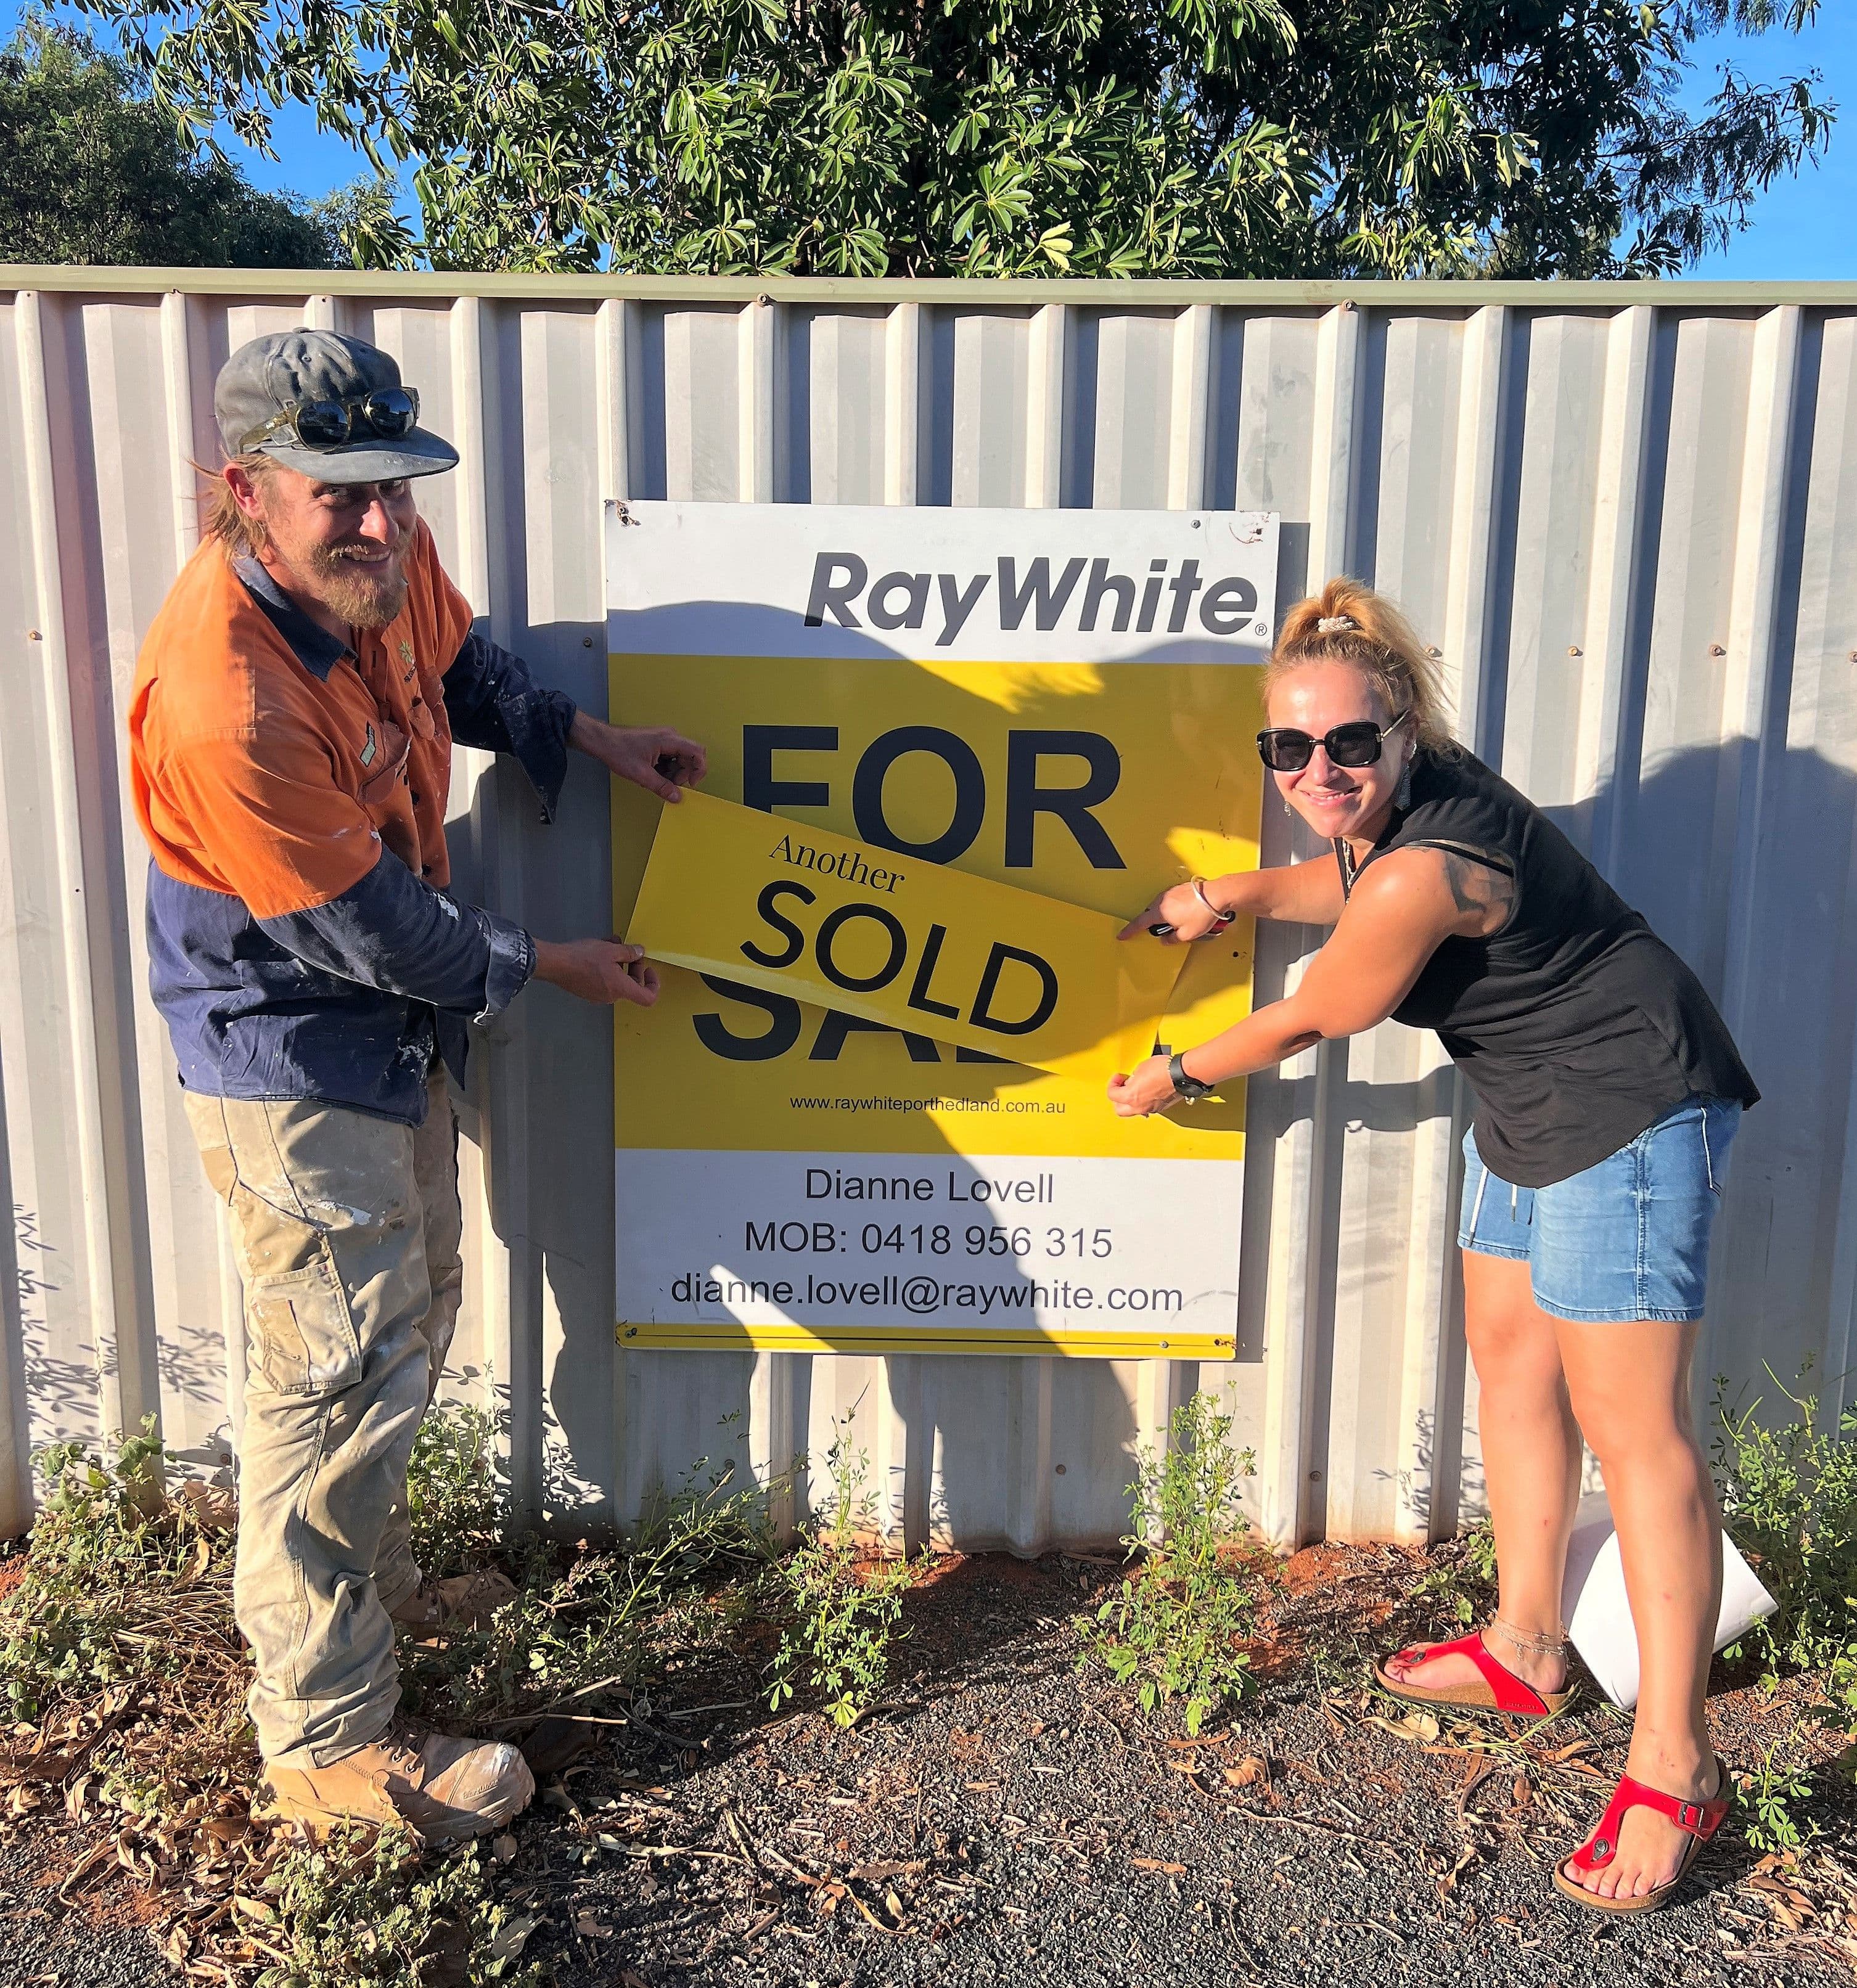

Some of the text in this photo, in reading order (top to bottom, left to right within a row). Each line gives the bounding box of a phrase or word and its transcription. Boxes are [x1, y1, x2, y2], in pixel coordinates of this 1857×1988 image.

[742, 724, 1127, 869] FOR
[768, 834, 905, 894] Another
[739, 880, 1059, 1035] SOLD
[790, 1095, 1065, 1114] www.raywhiteporthedland.com.au
[806, 1168, 1053, 1203] Dianne Lovell
[745, 1221, 1112, 1258] MOB: 0418 956 315
[671, 1272, 1183, 1314] dianne.lovell@raywhite.com
